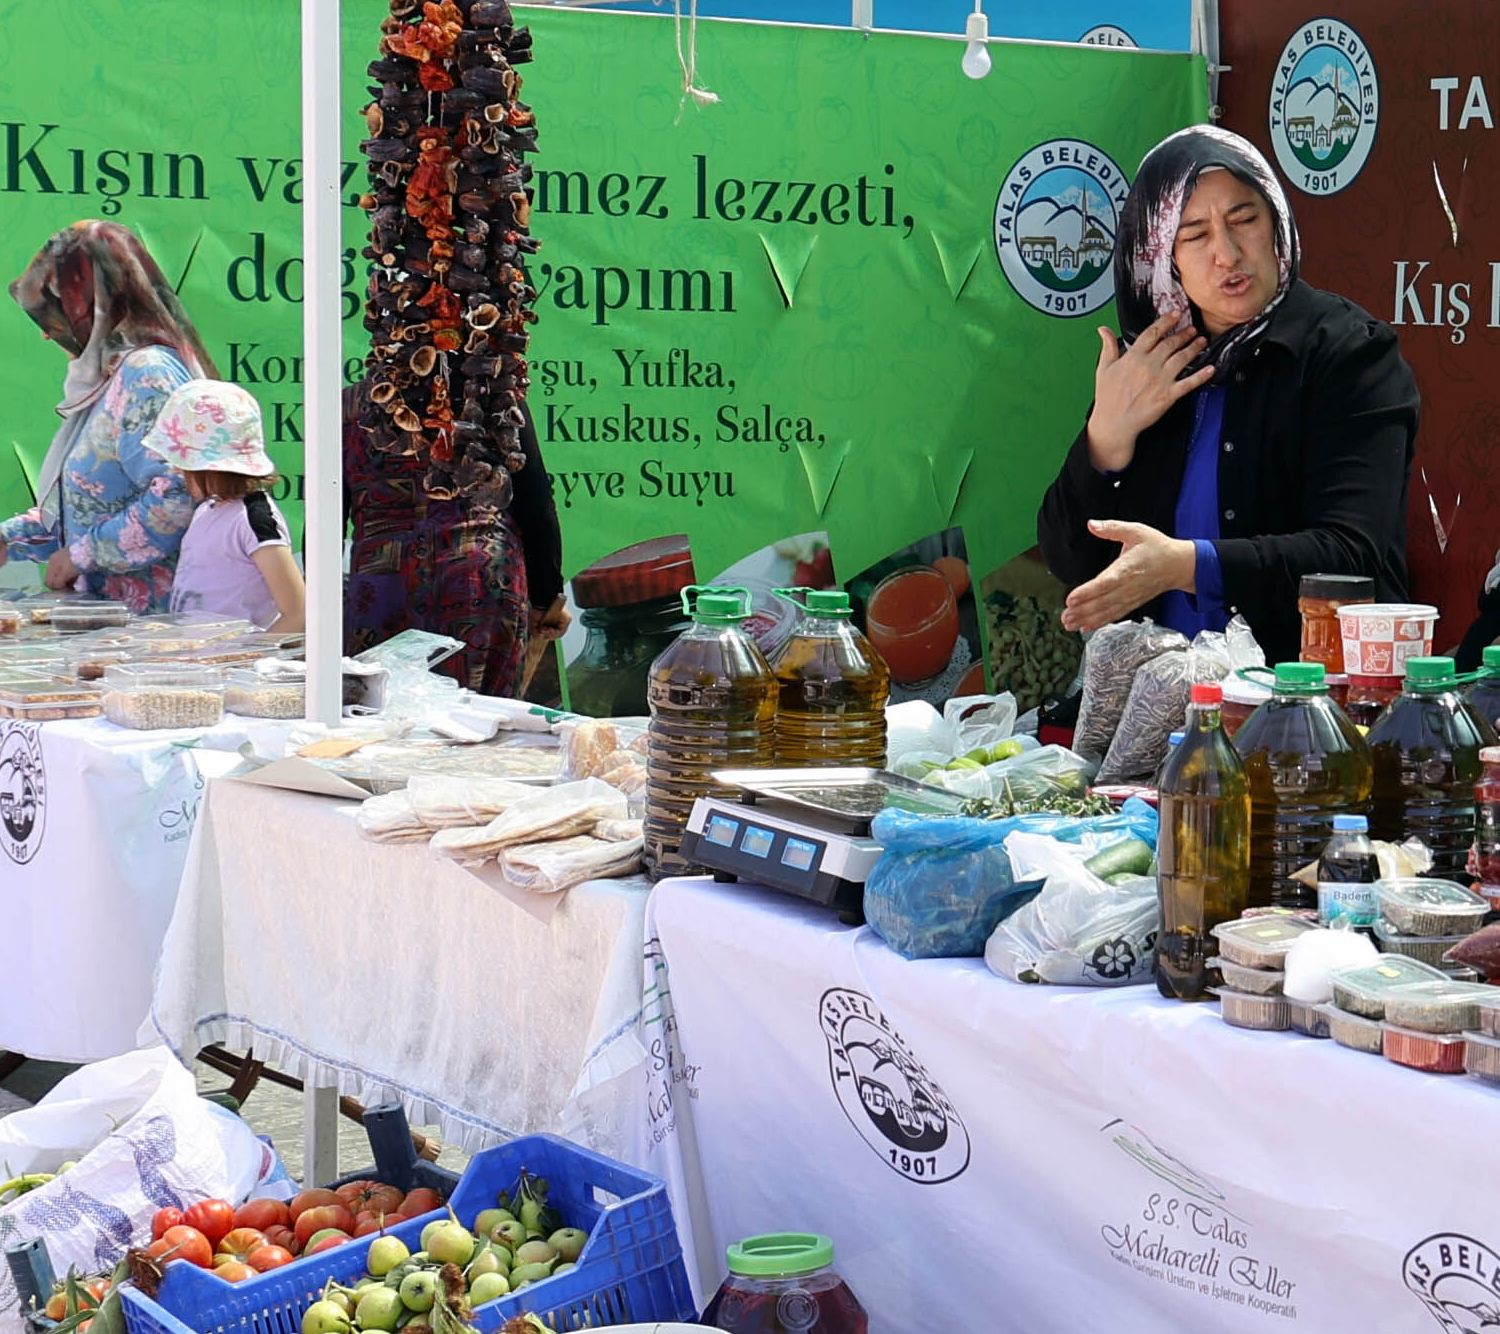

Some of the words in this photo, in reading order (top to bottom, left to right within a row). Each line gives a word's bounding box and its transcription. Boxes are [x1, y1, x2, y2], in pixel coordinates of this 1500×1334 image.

[1272, 48, 1298, 129] TALAS
[1303, 24, 1377, 125] BELEDİYESİ
[0, 121, 210, 216] Kışın
[694, 155, 916, 239] lezzeti,
[998, 165, 1033, 248] TALAS
[1042, 146, 1131, 205] BELEDİY
[1303, 170, 1339, 192] 1907
[1043, 292, 1090, 313] 1907
[1391, 259, 1472, 347] Kış
[612, 347, 736, 391] Yufka,
[544, 403, 702, 450] Kuskus,
[715, 404, 826, 452] Salça,
[639, 459, 736, 507] Suyu
[1332, 889, 1372, 902] Badem
[889, 1148, 937, 1176] 1907
[1184, 1202, 1248, 1249] Talas
[1101, 1223, 1220, 1278] Maharetli
[1229, 1255, 1297, 1299] Eller
[1199, 1284, 1210, 1296] ve
[1247, 1294, 1297, 1319] Kooperatifi
